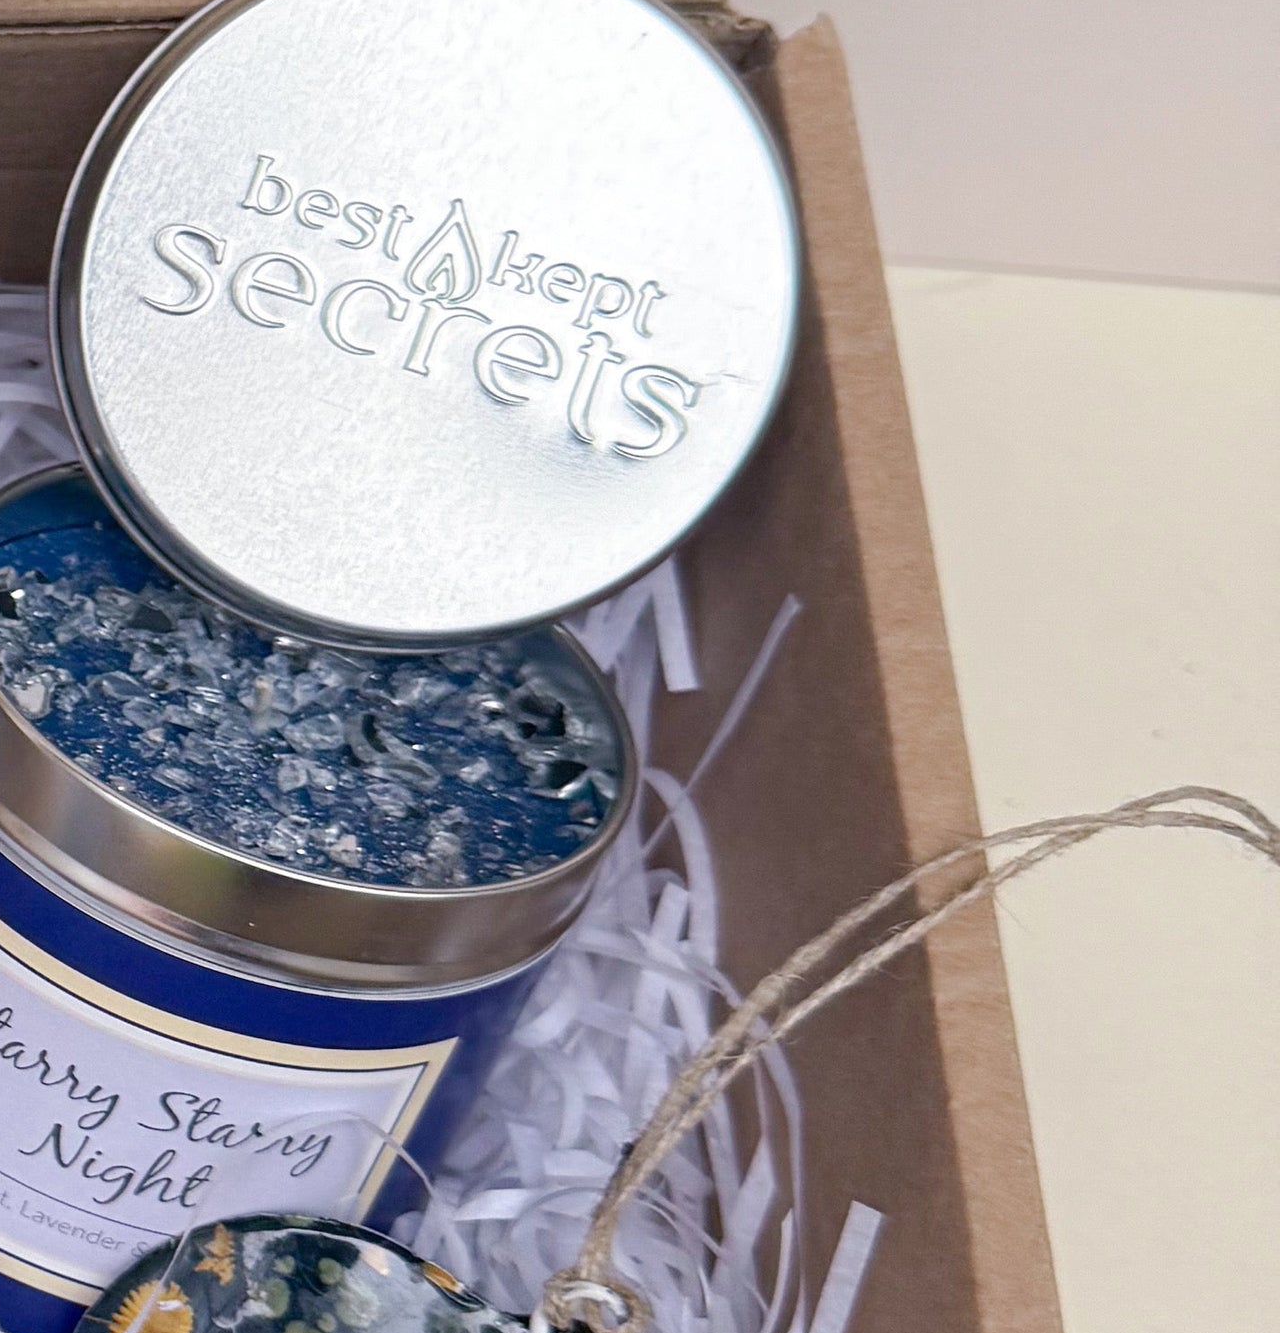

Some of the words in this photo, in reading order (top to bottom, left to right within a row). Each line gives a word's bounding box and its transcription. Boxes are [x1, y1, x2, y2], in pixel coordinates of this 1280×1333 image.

[240, 155, 414, 261] best
[489, 230, 666, 339] kept
[142, 223, 701, 460] secrets
[18, 1122, 214, 1208] Night
[19, 1199, 125, 1251] Lavender
